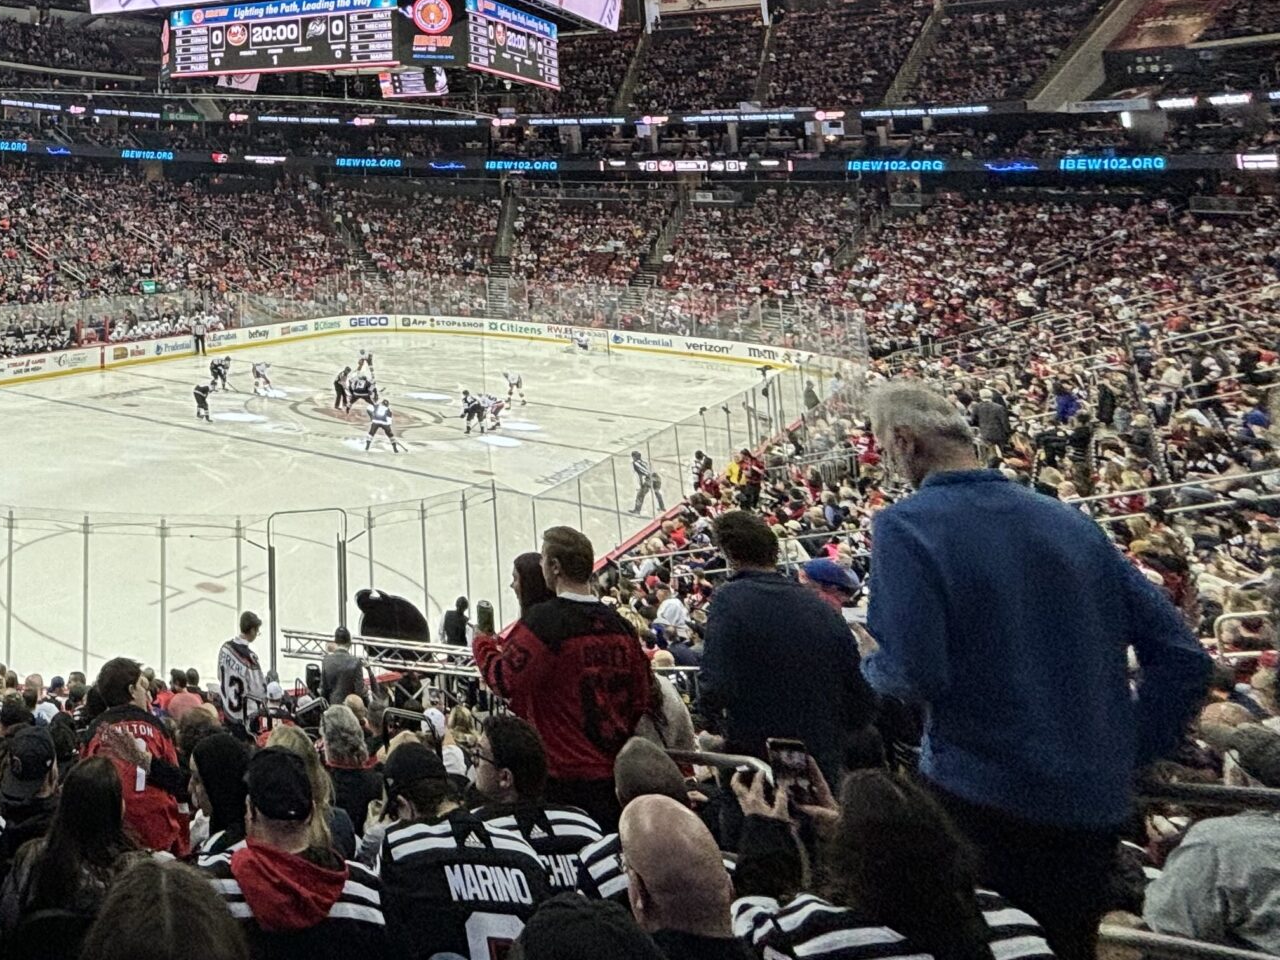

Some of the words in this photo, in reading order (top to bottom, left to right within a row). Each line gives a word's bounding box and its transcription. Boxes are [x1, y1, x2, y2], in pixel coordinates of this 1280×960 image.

[233, 5, 264, 18] Lighting
[265, 4, 278, 14] the
[280, 1, 300, 13] Path,
[212, 30, 223, 45] 0
[252, 24, 298, 41] 20:00
[332, 19, 344, 35] 0
[273, 55, 278, 65] 1
[121, 150, 174, 161] IBEW102.ORG
[336, 158, 401, 168] IBEW102.ORG
[485, 161, 557, 171] IBEW102.ORG
[847, 161, 944, 171] IBEW102.ORG
[1060, 157, 1165, 170] IBEW102.ORG
[350, 317, 389, 327] GEICO
[248, 328, 269, 339] betway
[500, 323, 542, 335] Citizens
[626, 335, 672, 347] Prudential
[164, 342, 192, 353] Prudential
[685, 342, 729, 354] verizon
[220, 665, 244, 714] 13
[444, 864, 534, 905] MARINO
